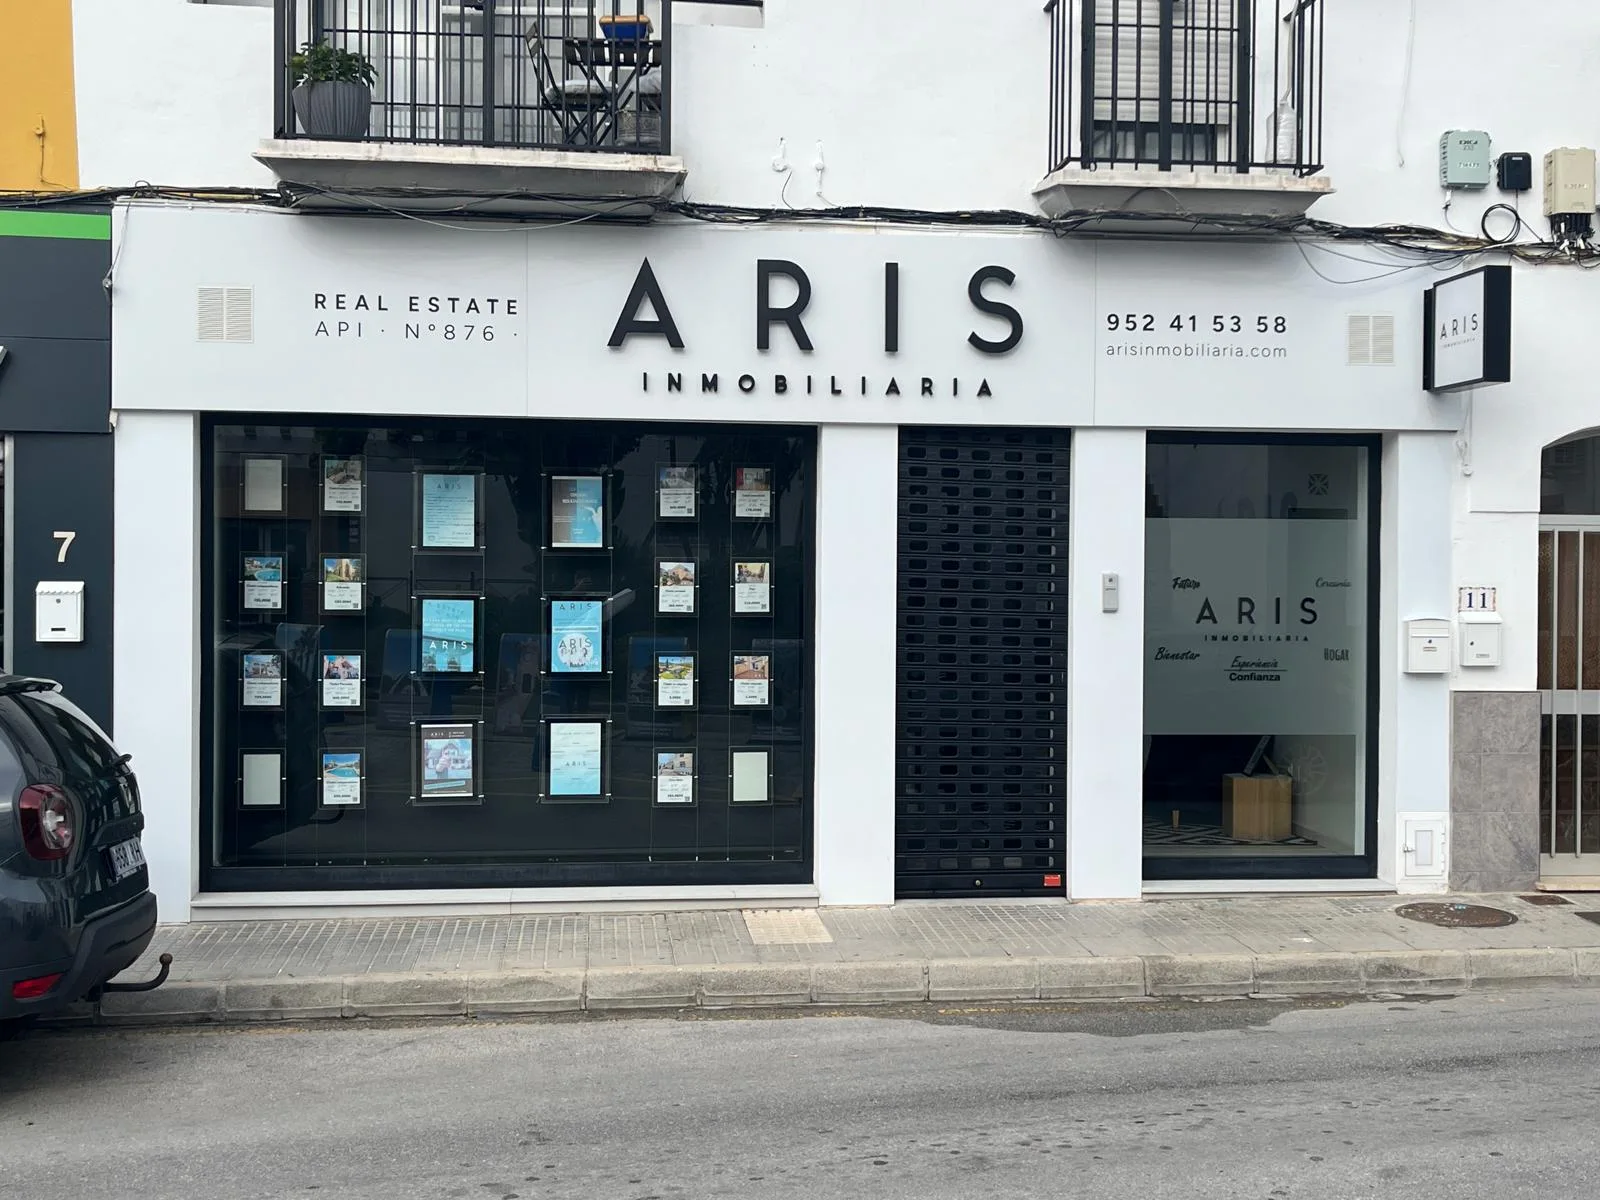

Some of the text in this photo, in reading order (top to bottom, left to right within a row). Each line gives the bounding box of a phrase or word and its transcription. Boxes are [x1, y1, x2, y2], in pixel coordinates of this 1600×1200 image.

[314, 293, 517, 315] REAL ESTATE
[606, 256, 1024, 354] ARIS
[315, 320, 362, 338] API
[1107, 314, 1287, 333] 952 41 53 58
[1440, 313, 1478, 339] ARIS
[1106, 342, 1287, 358] arisinmobiliaria.com
[642, 372, 992, 398] INMOBILIARIA
[53, 531, 76, 563] 7
[1467, 592, 1487, 608] 11
[1195, 596, 1318, 625] ARIS
[429, 641, 468, 650] ARIS
[1204, 634, 1309, 642] INMOBILIARIA
[1154, 646, 1200, 661] Bienestar
[1228, 672, 1281, 682] Confianza
